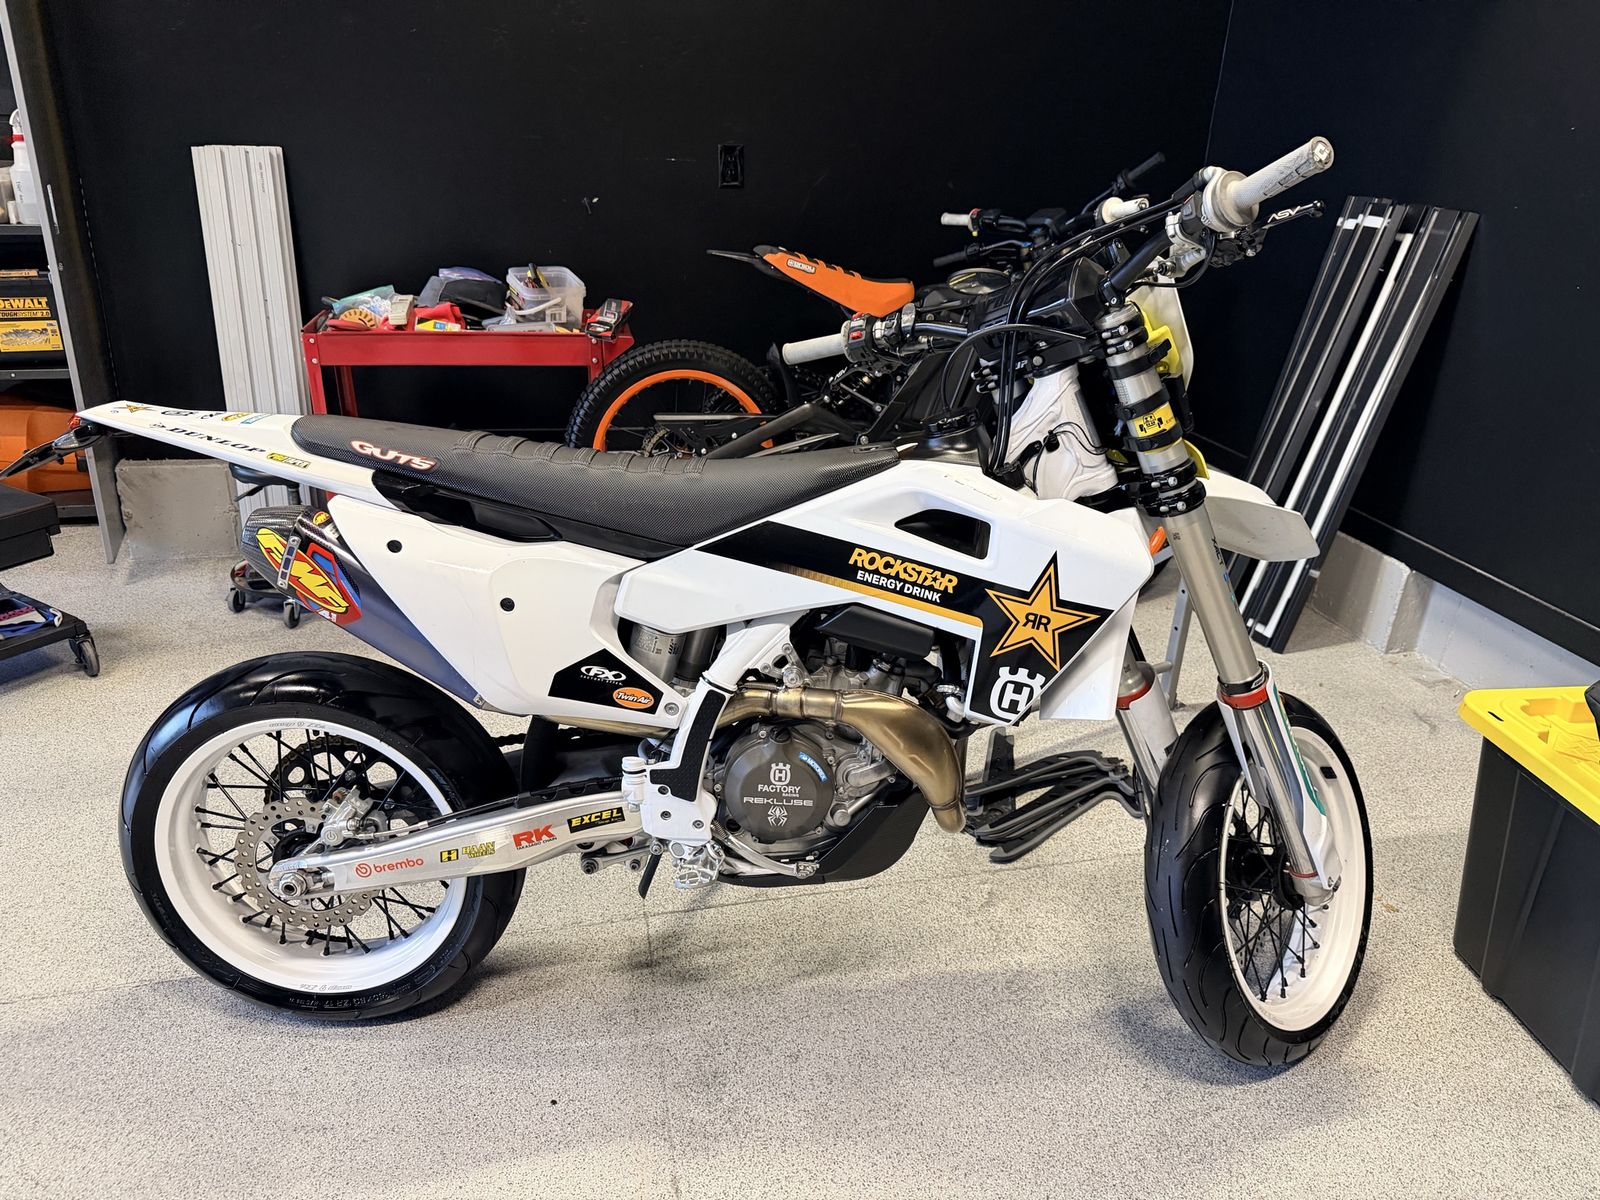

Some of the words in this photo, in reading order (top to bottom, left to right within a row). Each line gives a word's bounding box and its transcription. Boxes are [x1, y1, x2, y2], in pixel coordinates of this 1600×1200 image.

[1267, 205, 1301, 223] ASV
[163, 426, 267, 453] DUNLOP
[350, 440, 438, 471] GUTS
[255, 533, 349, 608] FMF
[848, 547, 959, 594] ROCKSTAR
[856, 569, 904, 591] ENERGY
[903, 583, 942, 603] DRINK
[617, 691, 637, 702] Twin
[637, 696, 653, 704] Air
[757, 784, 801, 793] FACTORY
[743, 796, 814, 807] REKLUSE
[571, 809, 622, 827] EXCEL
[512, 824, 556, 848] RK
[373, 858, 424, 873] brembo
